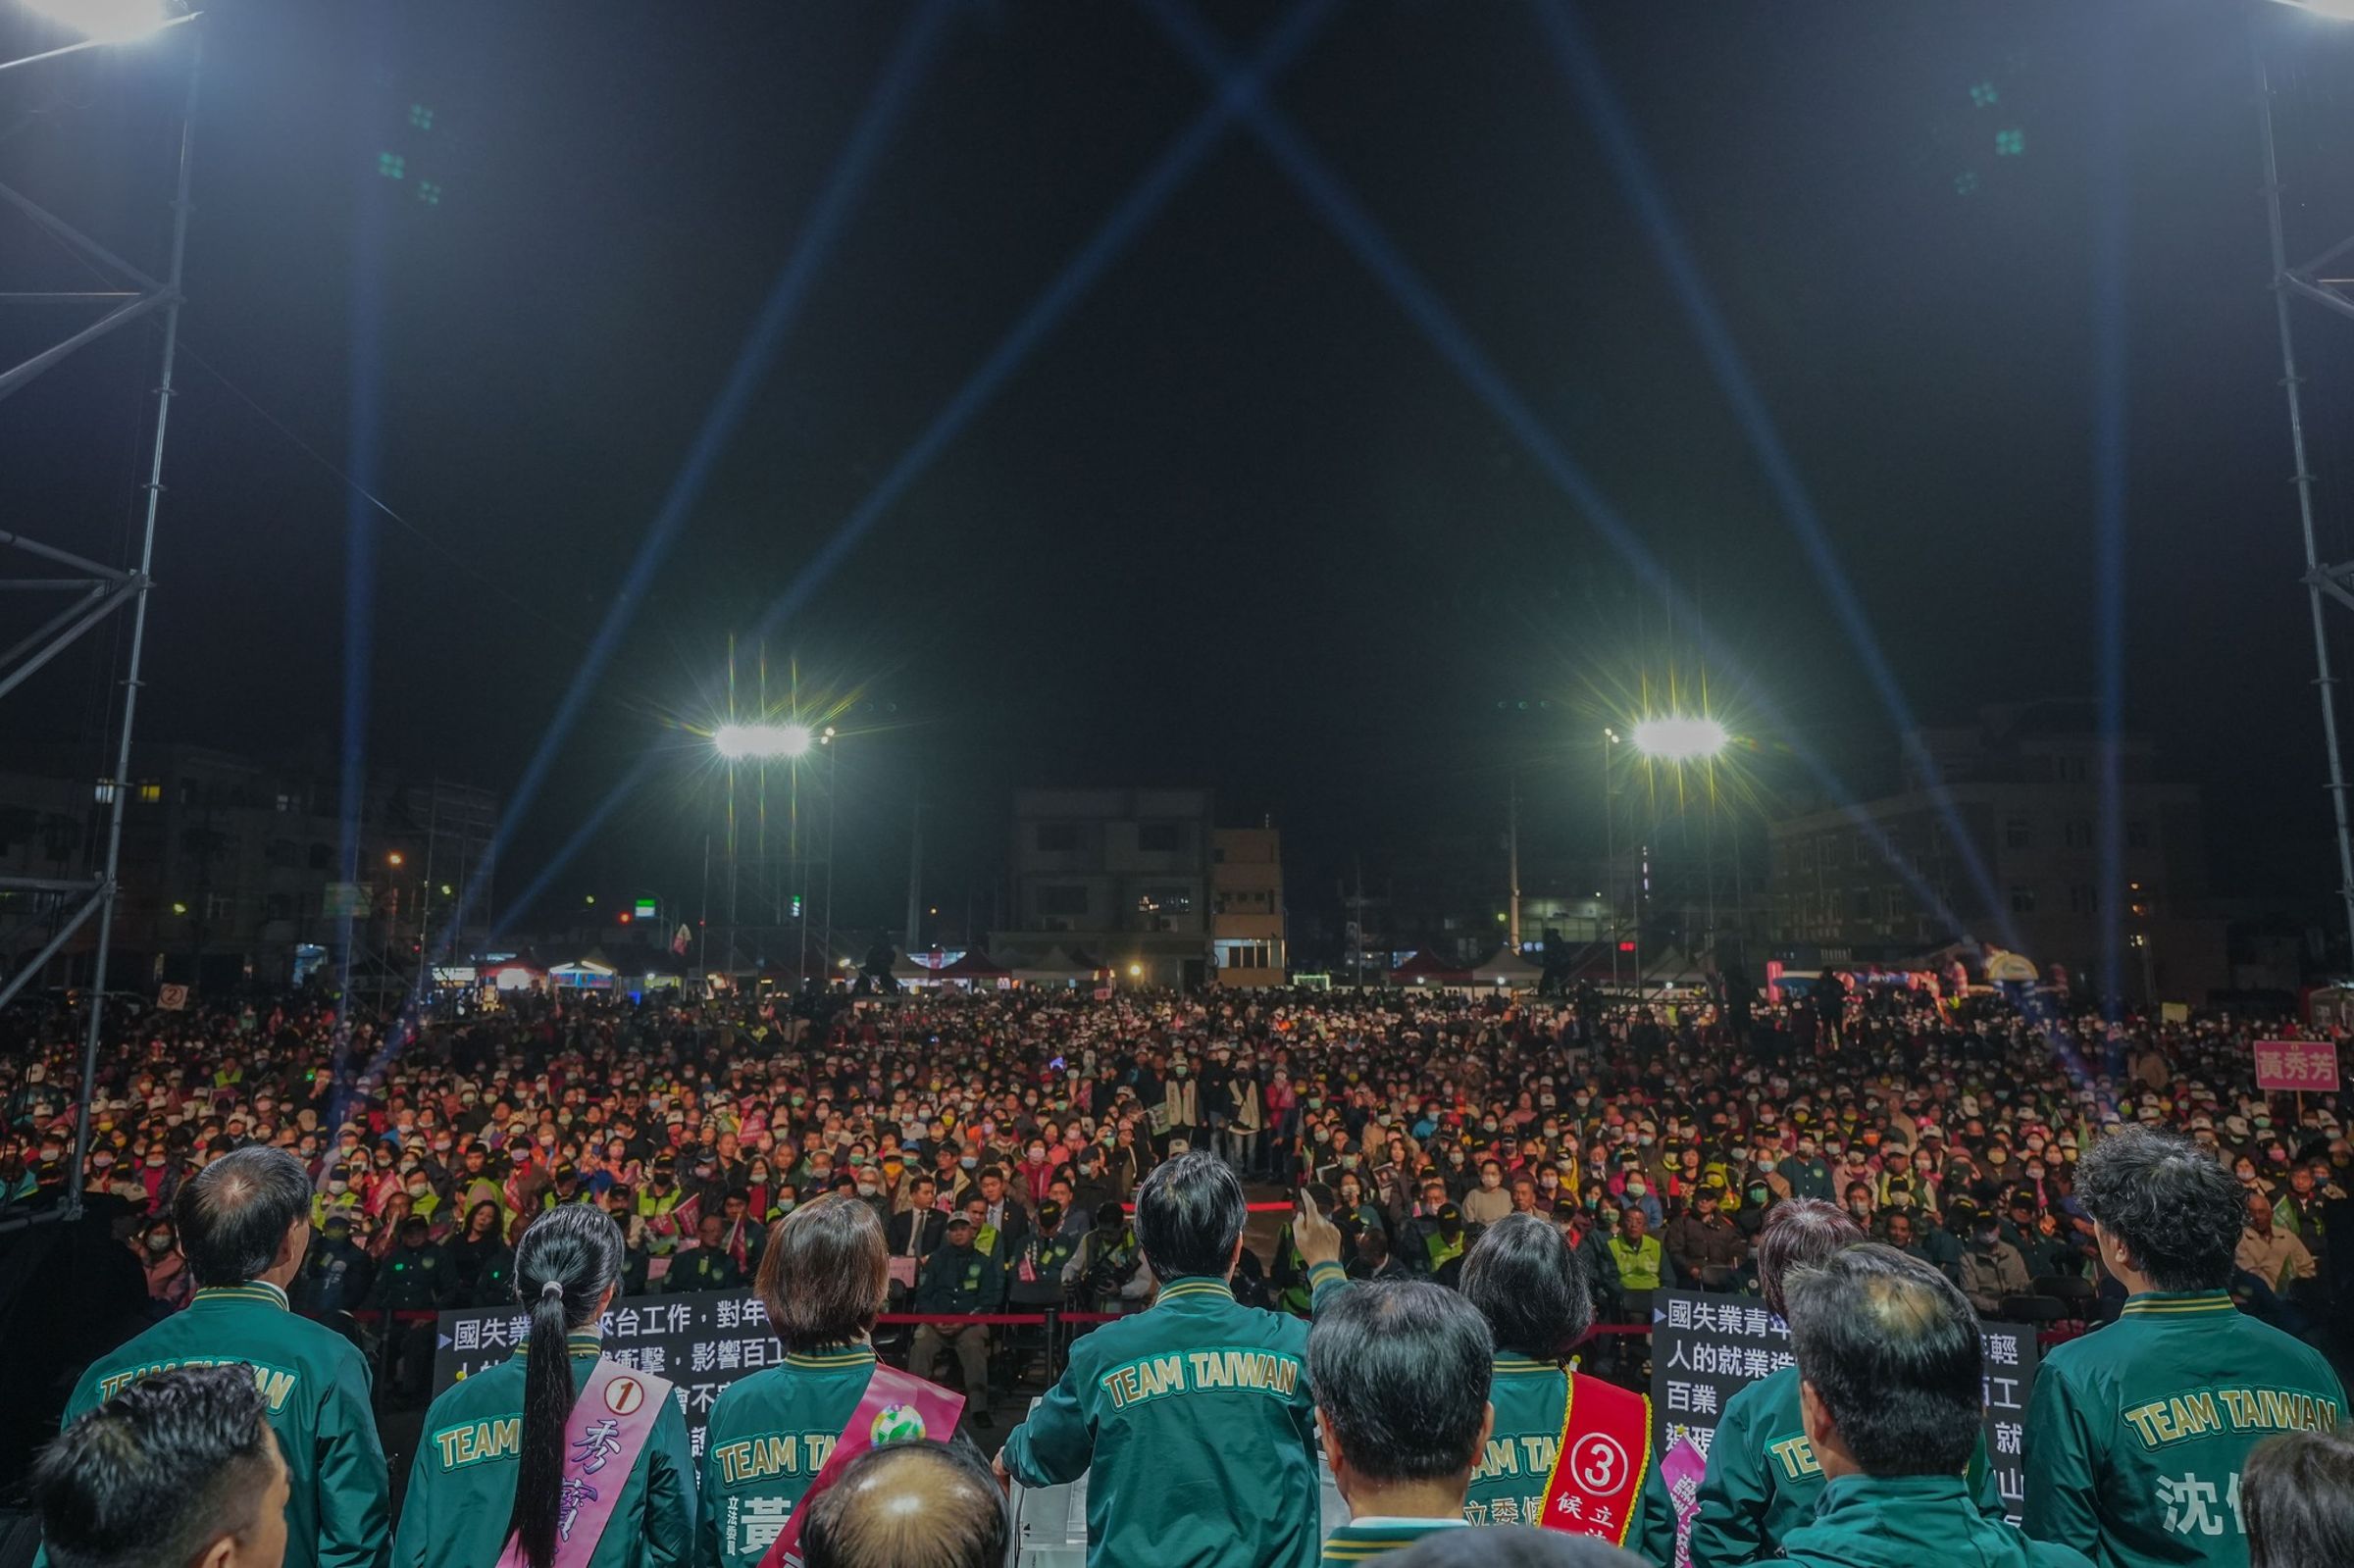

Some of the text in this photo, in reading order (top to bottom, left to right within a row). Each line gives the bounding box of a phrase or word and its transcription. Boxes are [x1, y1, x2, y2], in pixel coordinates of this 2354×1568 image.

[2259, 1050, 2334, 1082] 黃秀芳
[1982, 1334, 2019, 1366] 輕
[1102, 1351, 1299, 1408] TEAM TAIWAN
[1666, 1380, 2022, 1455] 百業 就
[2124, 1389, 2337, 1446] TEAM TAIWAN
[436, 1418, 522, 1468] TEAM
[715, 1436, 796, 1484] TEAM
